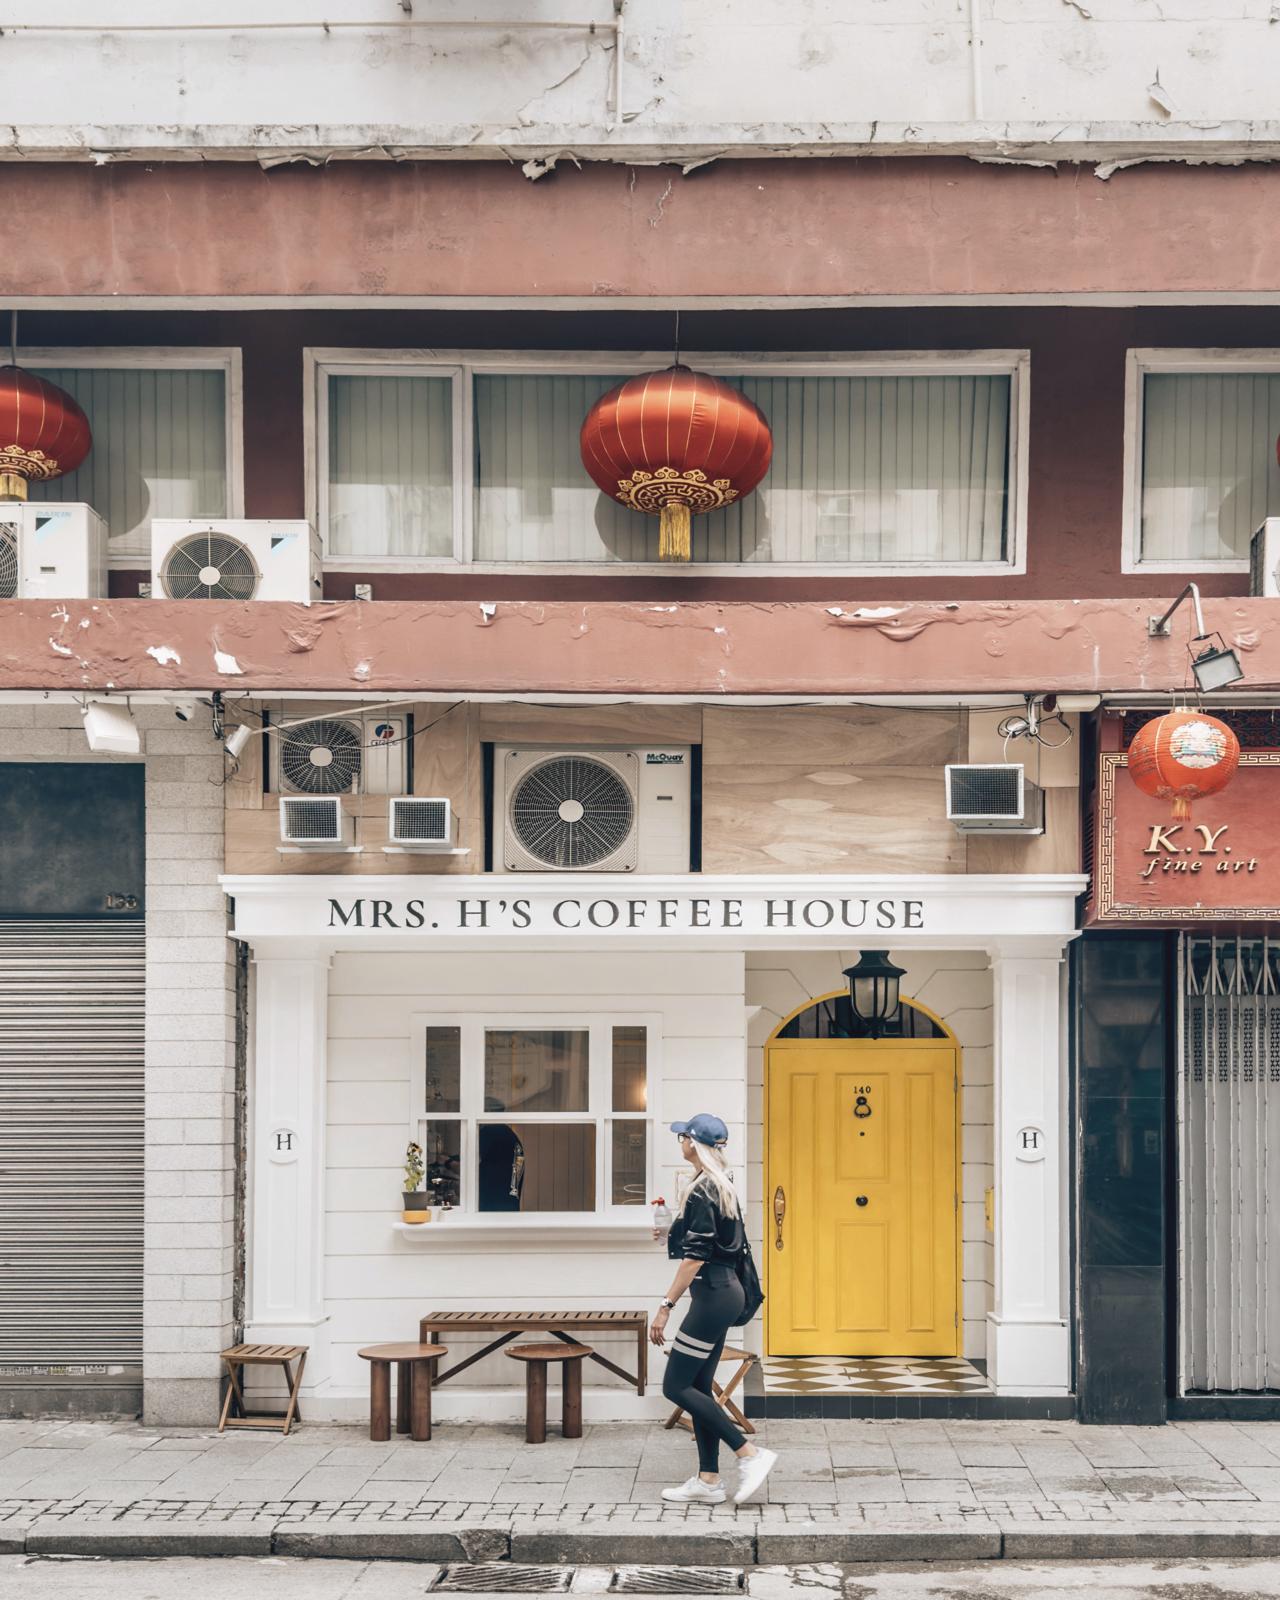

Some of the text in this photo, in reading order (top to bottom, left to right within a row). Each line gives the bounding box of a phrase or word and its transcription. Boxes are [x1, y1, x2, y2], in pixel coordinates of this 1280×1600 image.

[646, 753, 684, 761] McQuay
[1143, 825, 1231, 854] K.Y.
[1142, 857, 1258, 877] fine art
[327, 898, 924, 929] MRS. H'S COFFEE HOUSE
[853, 1085, 872, 1094] 140
[276, 1133, 293, 1150] H
[1022, 1131, 1038, 1149] H
